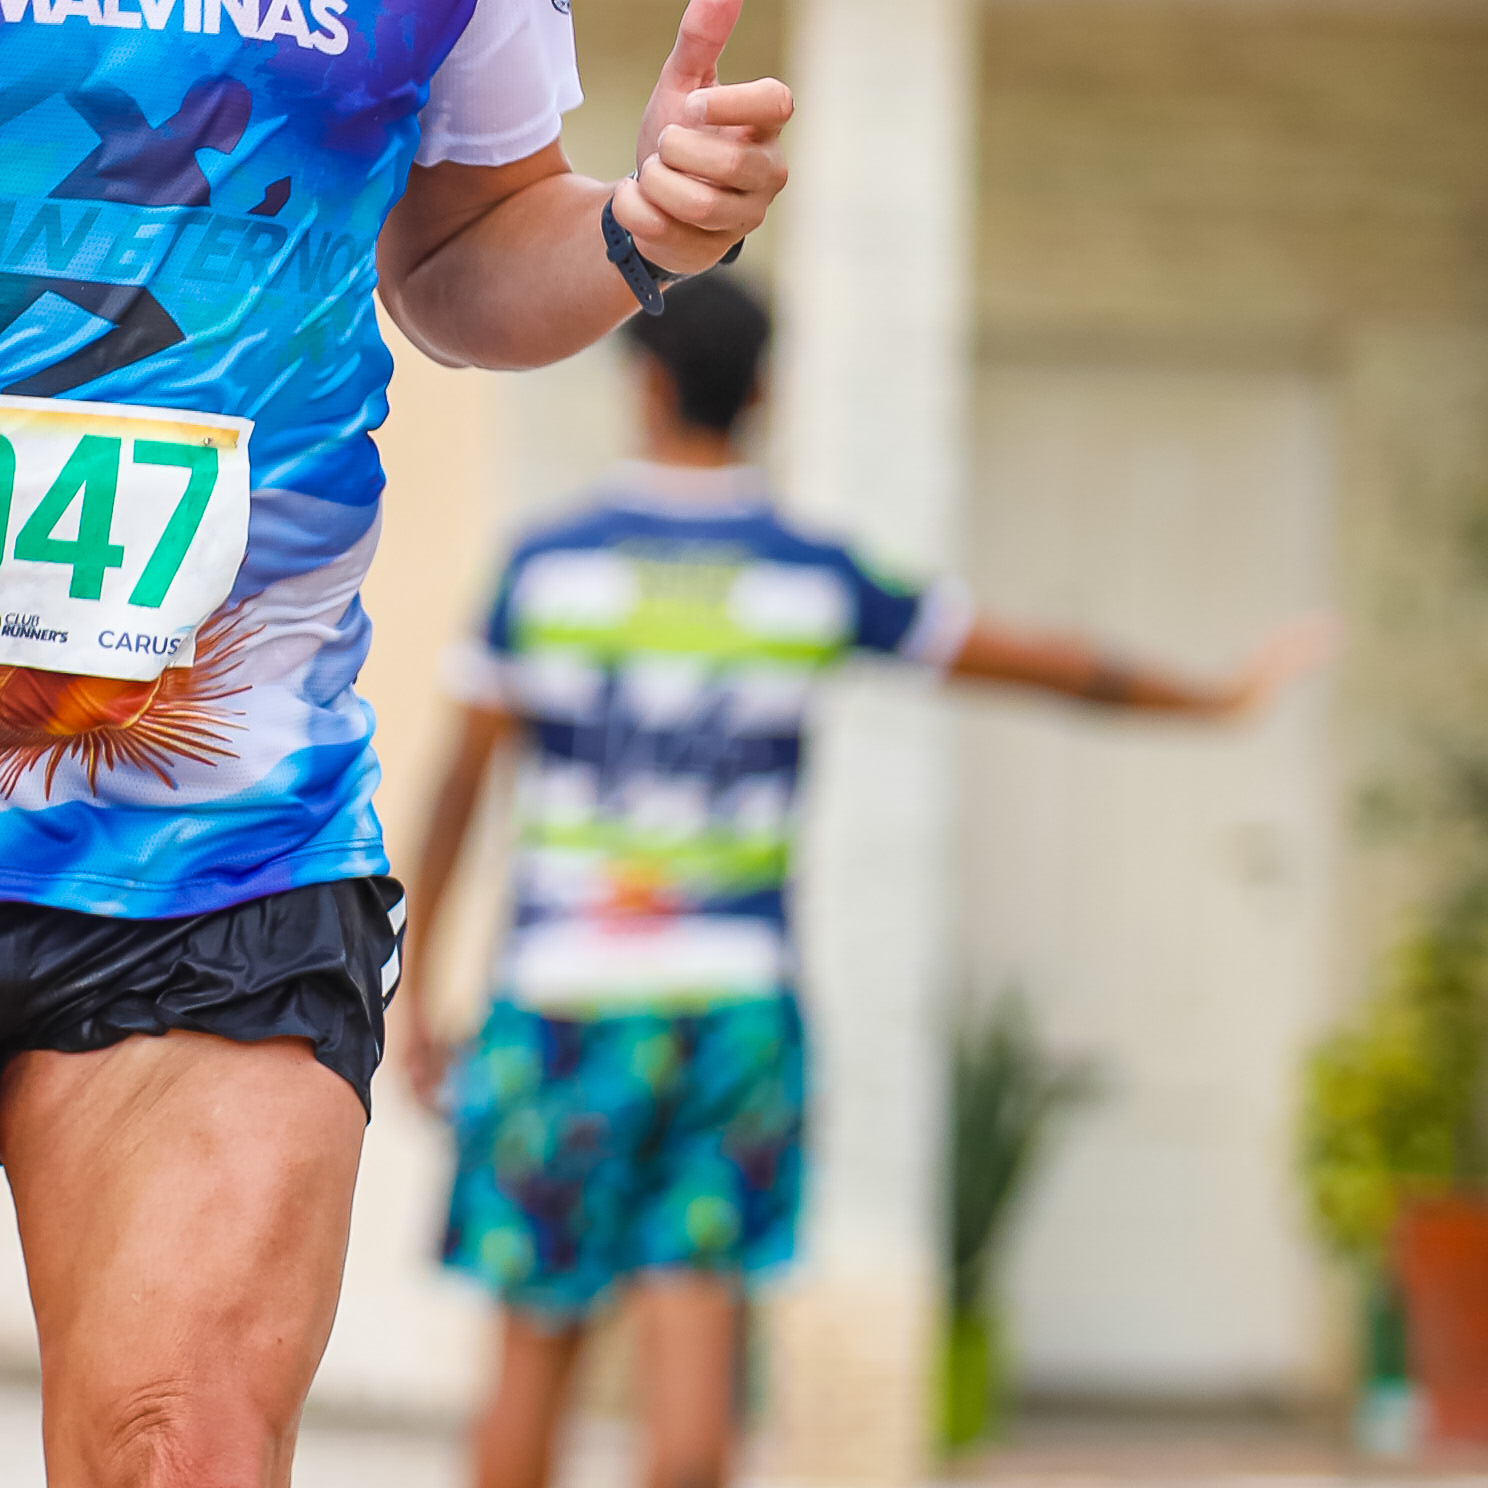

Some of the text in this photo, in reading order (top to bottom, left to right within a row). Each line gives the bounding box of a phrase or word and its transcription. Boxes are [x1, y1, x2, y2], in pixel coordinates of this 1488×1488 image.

[96, 207, 374, 295] ETERNO
[4, 612, 40, 627] CLUB
[0, 623, 69, 643] RUNNER'S
